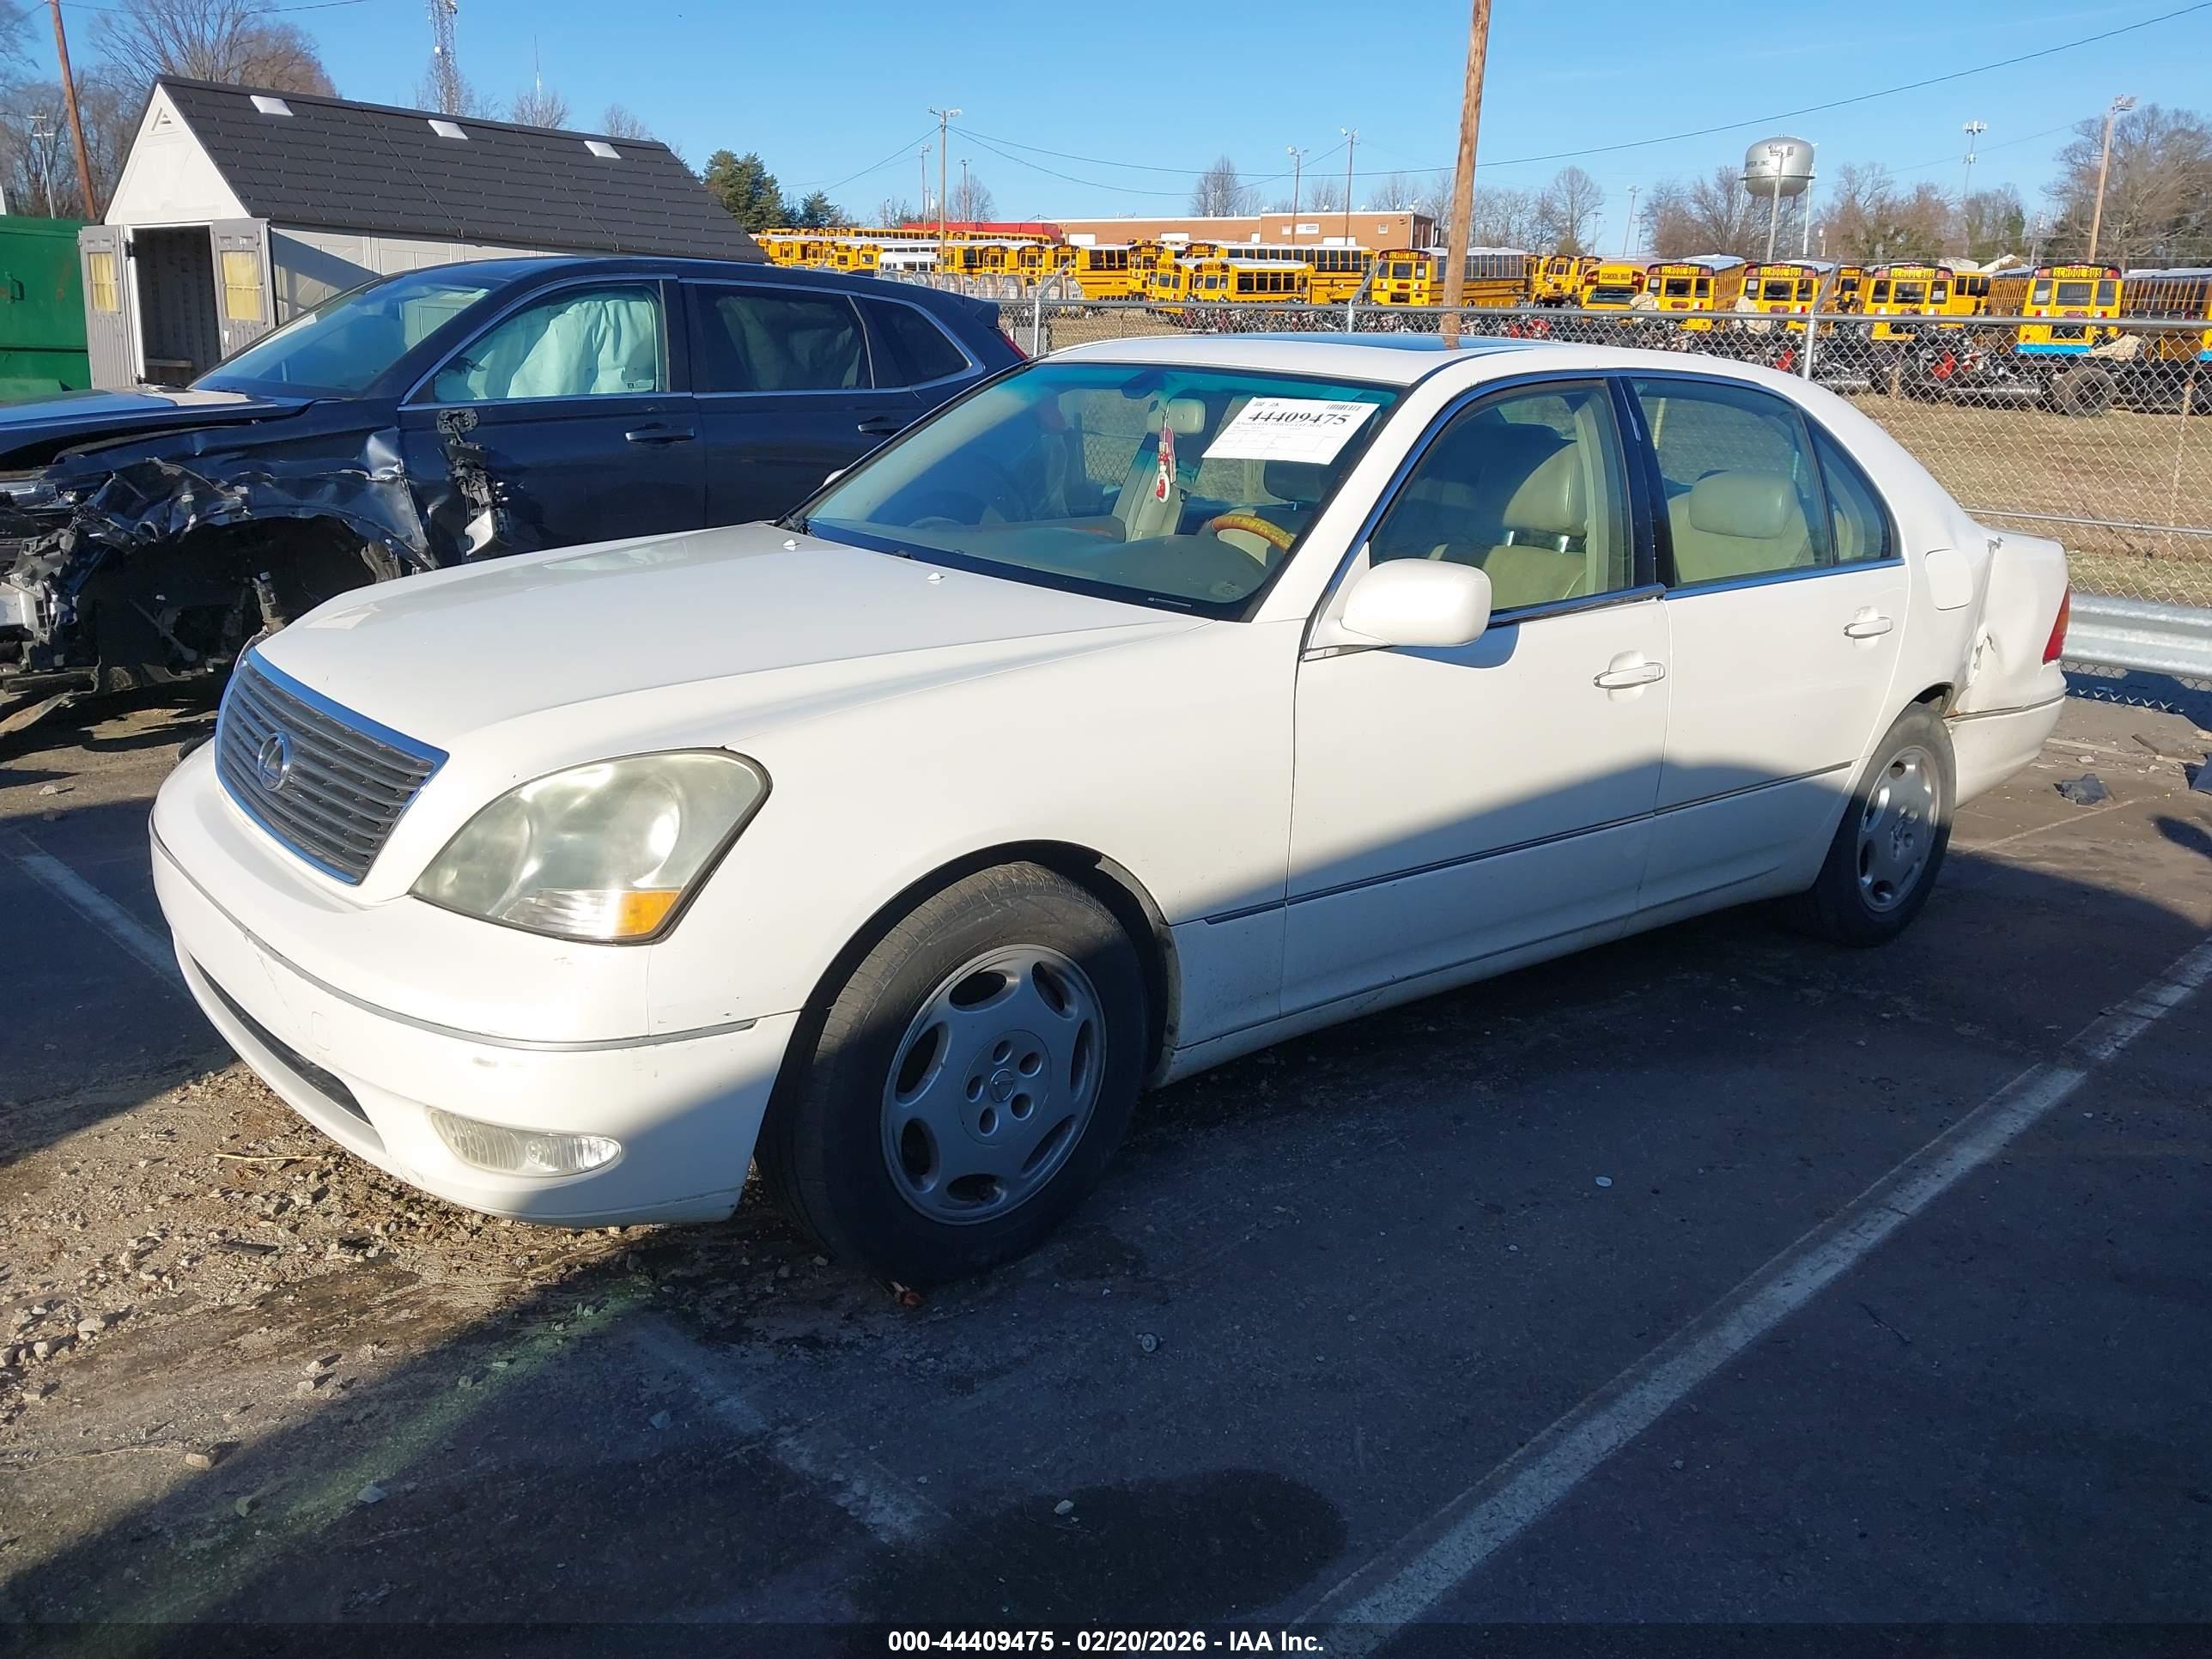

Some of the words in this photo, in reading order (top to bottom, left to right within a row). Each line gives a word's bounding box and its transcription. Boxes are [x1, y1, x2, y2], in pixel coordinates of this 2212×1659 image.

[1892, 268, 1919, 278] SCHOOL
[1921, 269, 1935, 278] BUS
[2053, 268, 2084, 277] SCHOOL
[2087, 268, 2102, 278] BUS
[1248, 410, 1351, 425] 44409475
